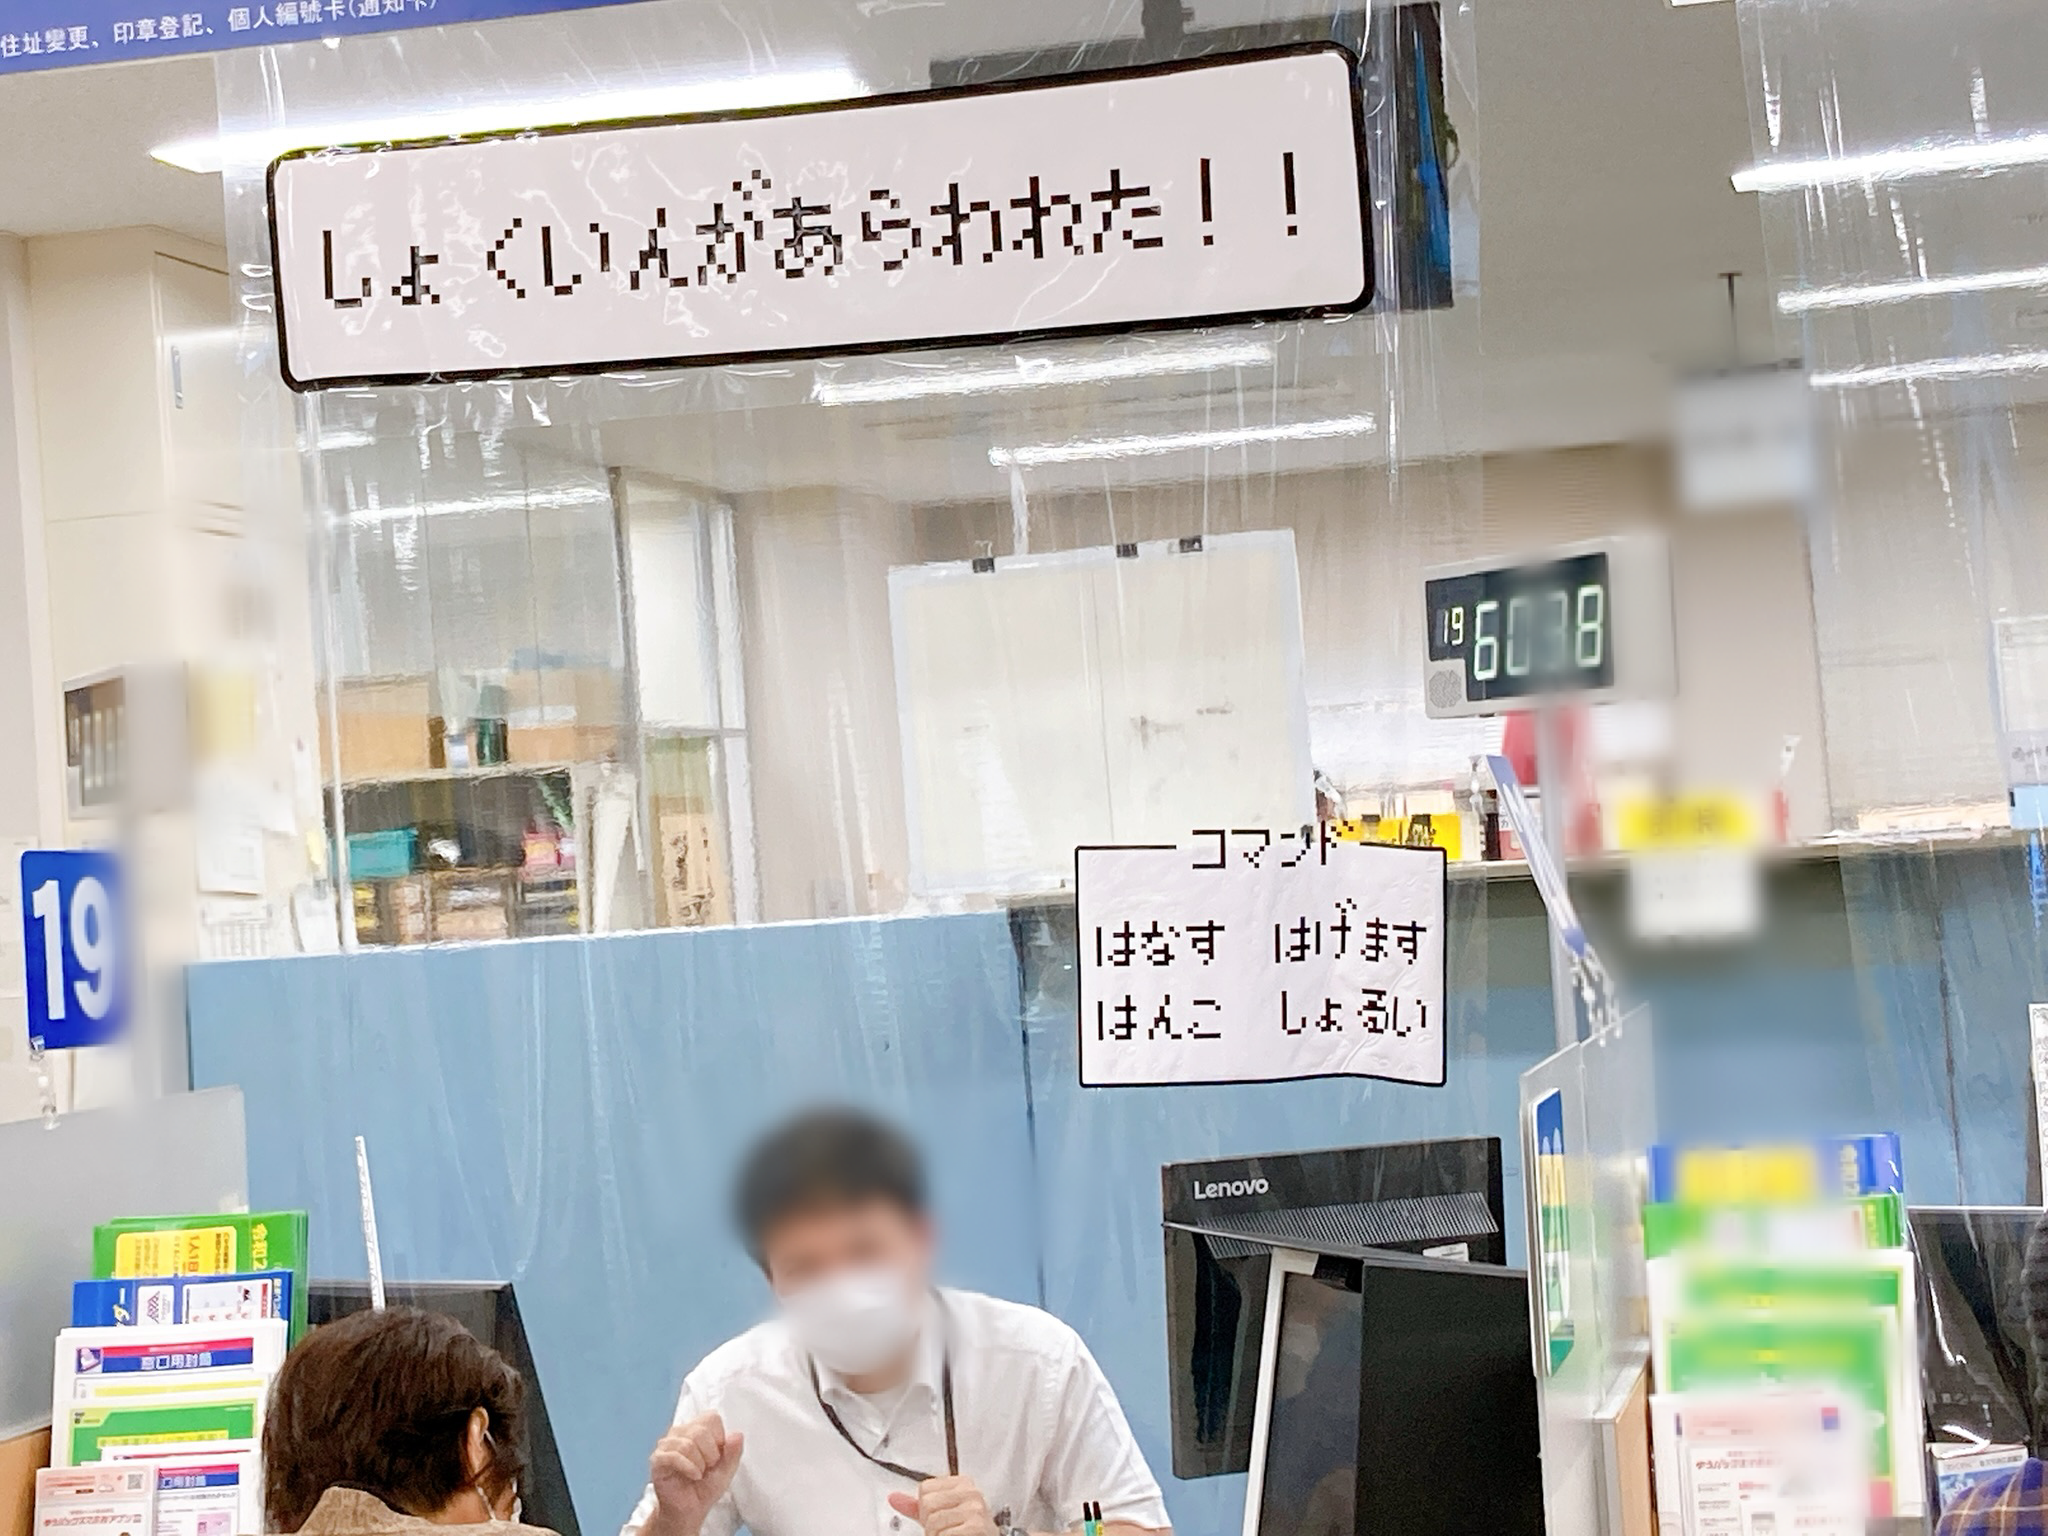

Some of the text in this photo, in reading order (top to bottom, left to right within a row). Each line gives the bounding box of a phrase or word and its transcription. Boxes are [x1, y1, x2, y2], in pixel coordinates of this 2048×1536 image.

[1443, 606, 1464, 646] 19
[1192, 820, 1354, 869] コマンド
[32, 876, 115, 1020] 19
[1096, 898, 1427, 967] はなす はげます
[1098, 988, 1427, 1041] はんこ しょるい
[1194, 1178, 1269, 1200] Lenovo
